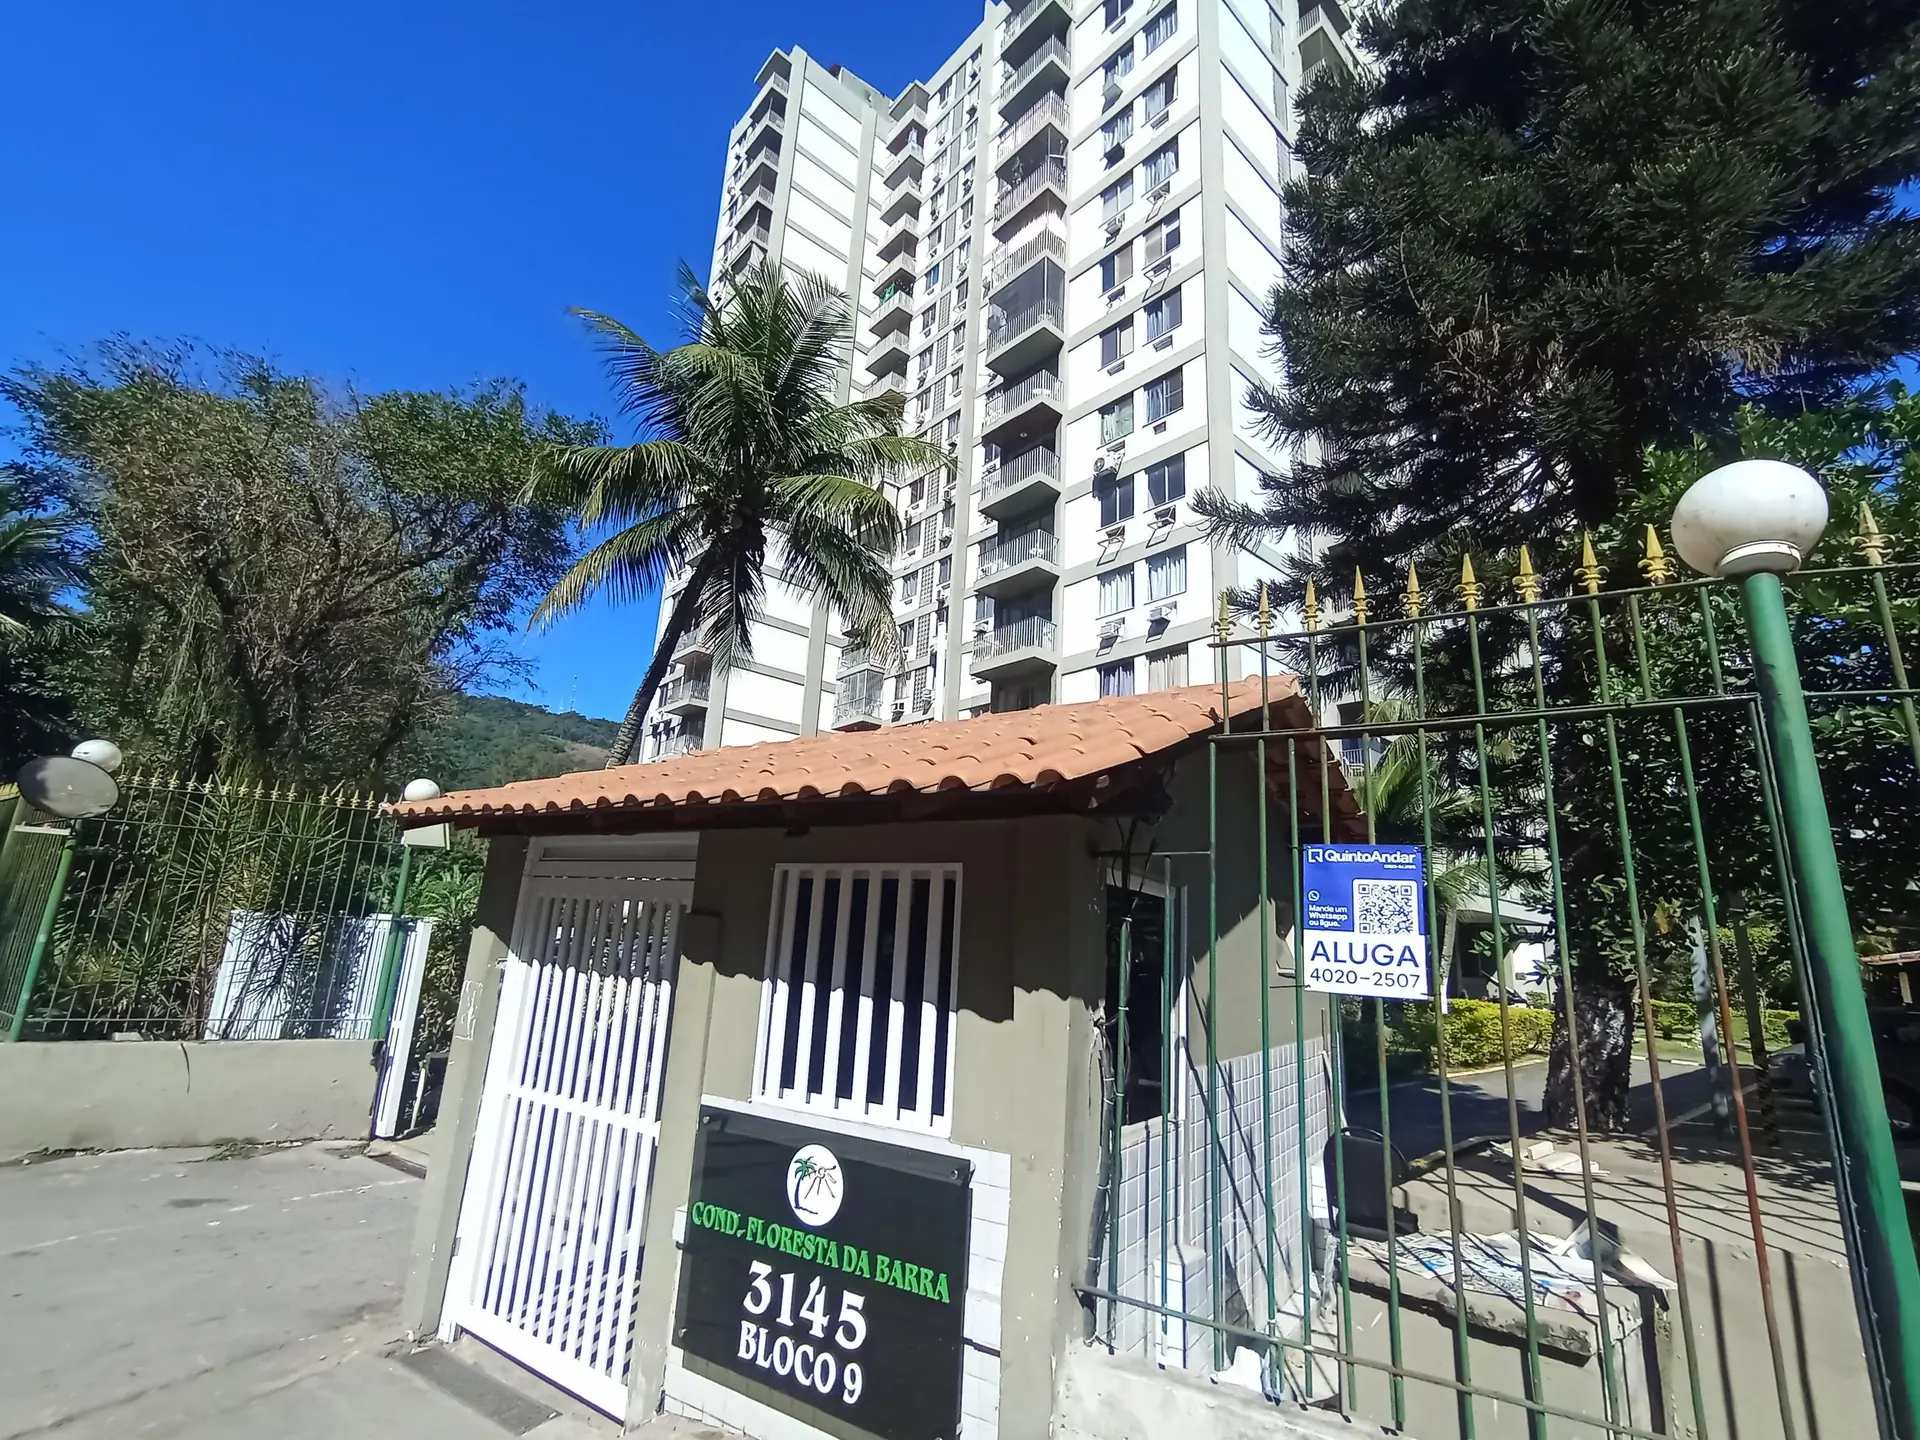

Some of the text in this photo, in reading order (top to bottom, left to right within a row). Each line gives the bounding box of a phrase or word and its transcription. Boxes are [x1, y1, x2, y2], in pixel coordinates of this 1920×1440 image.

[1324, 849, 1416, 864] QuintoAndar
[1308, 904, 1334, 912] Mande
[1310, 940, 1420, 968] ALUGA
[1310, 968, 1420, 988] 4020-2507
[692, 1201, 950, 1303] COND. FLORESTA DA BARRA
[743, 1259, 867, 1350] 3145
[737, 1320, 863, 1404] BLOCO 9
